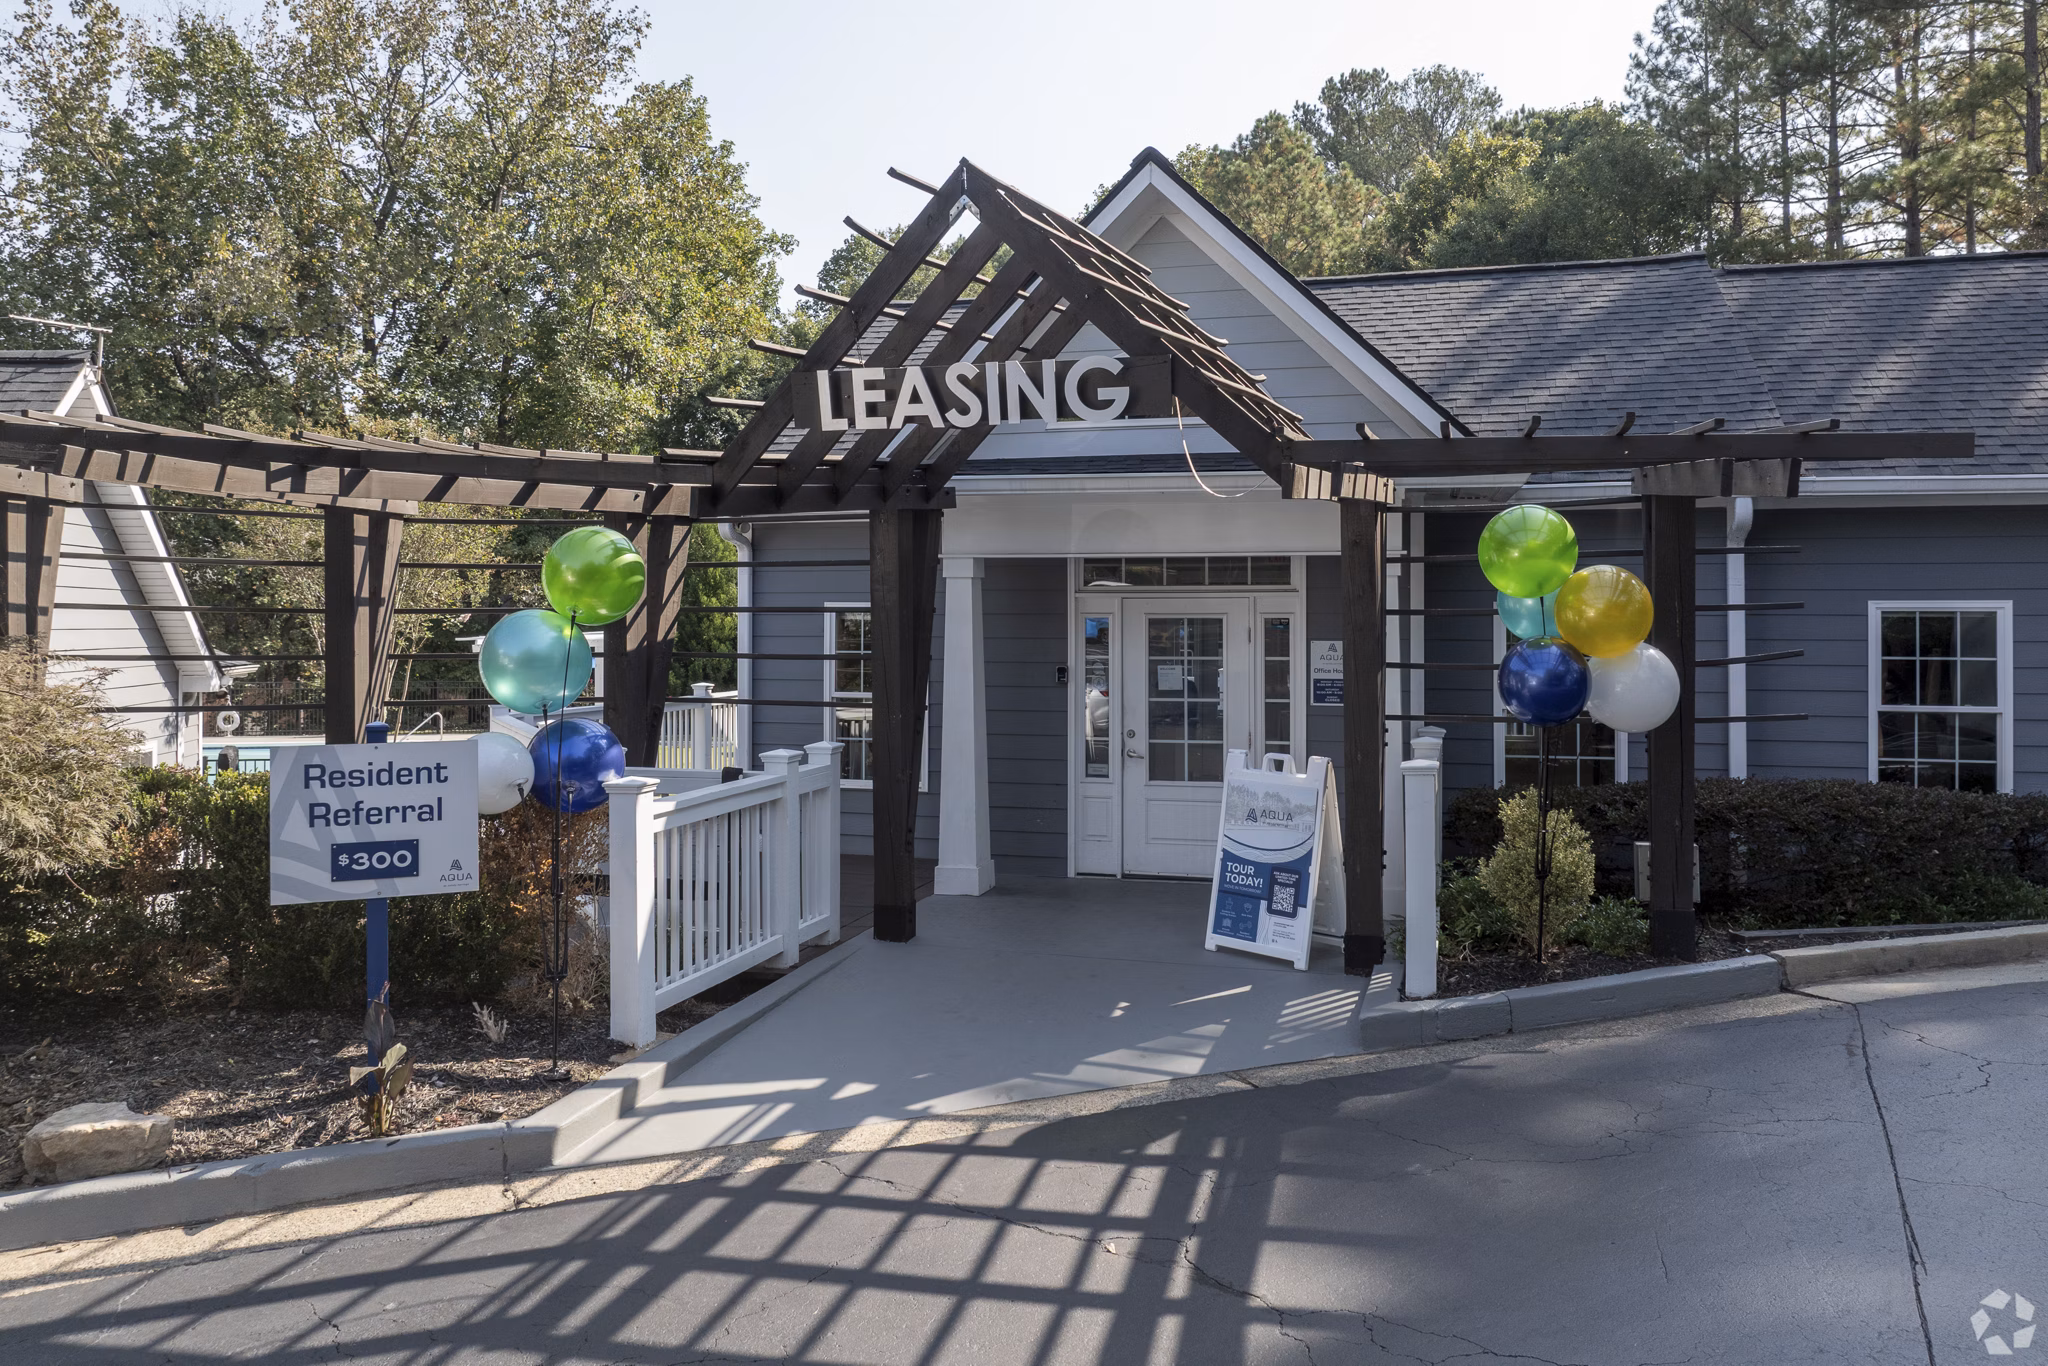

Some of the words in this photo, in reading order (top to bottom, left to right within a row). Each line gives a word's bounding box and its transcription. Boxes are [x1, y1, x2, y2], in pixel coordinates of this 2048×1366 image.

[817, 355, 1130, 431] LEASING
[304, 761, 449, 790] Resident
[308, 797, 443, 828] Referral
[1260, 809, 1293, 823] AQUA
[338, 850, 413, 871] $300
[1226, 862, 1255, 876] TOUR
[439, 872, 473, 883] AQUA
[1225, 873, 1264, 888] TODAY!
